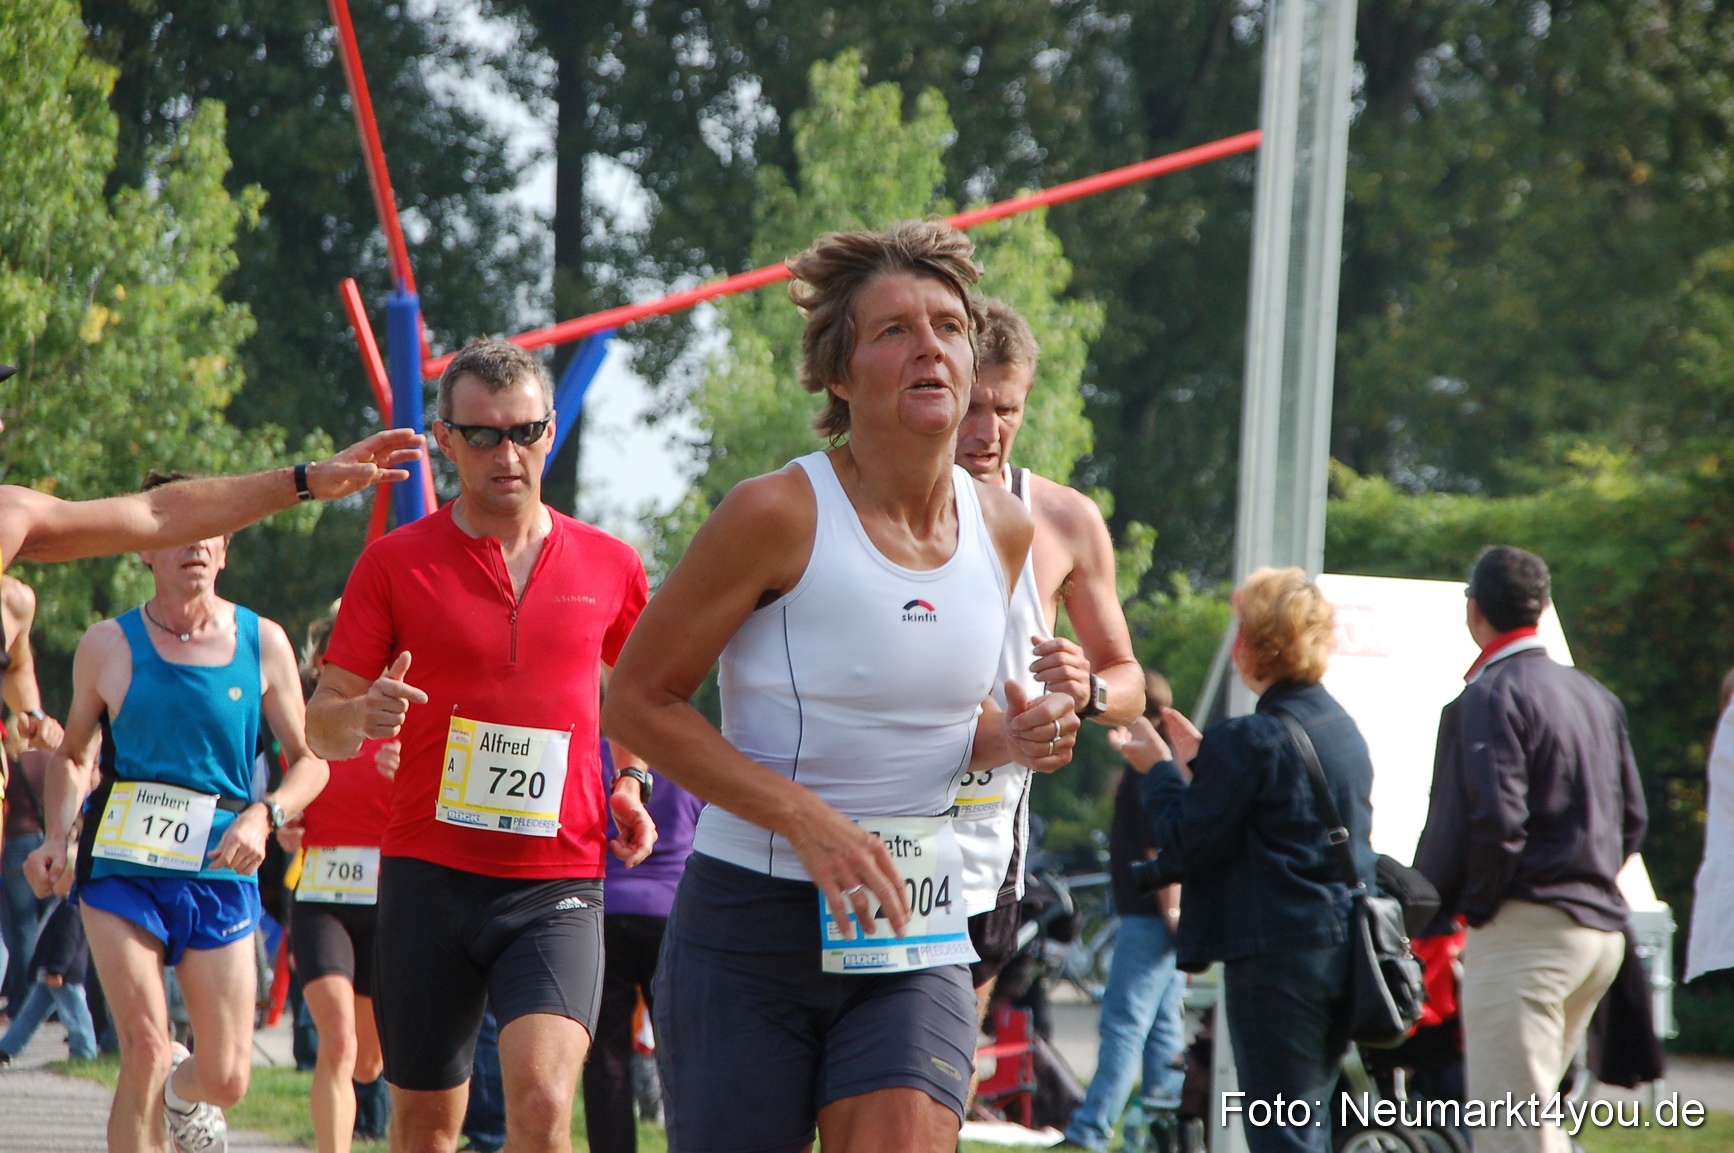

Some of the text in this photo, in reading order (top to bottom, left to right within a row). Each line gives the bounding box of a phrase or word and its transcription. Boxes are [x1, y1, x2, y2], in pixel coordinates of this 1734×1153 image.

[902, 613, 937, 622] skinfit
[480, 732, 531, 756] Alfred
[448, 757, 454, 772] A
[489, 766, 546, 799] 720
[136, 789, 190, 811] Herbert
[107, 810, 114, 820] A
[513, 817, 556, 829] PFLEIDERER
[142, 815, 190, 844] 170
[868, 831, 922, 857] etra
[327, 861, 363, 881] 708
[874, 876, 952, 919] 004
[843, 952, 889, 965] BOCK
[920, 943, 971, 959] PFLEIDERER
